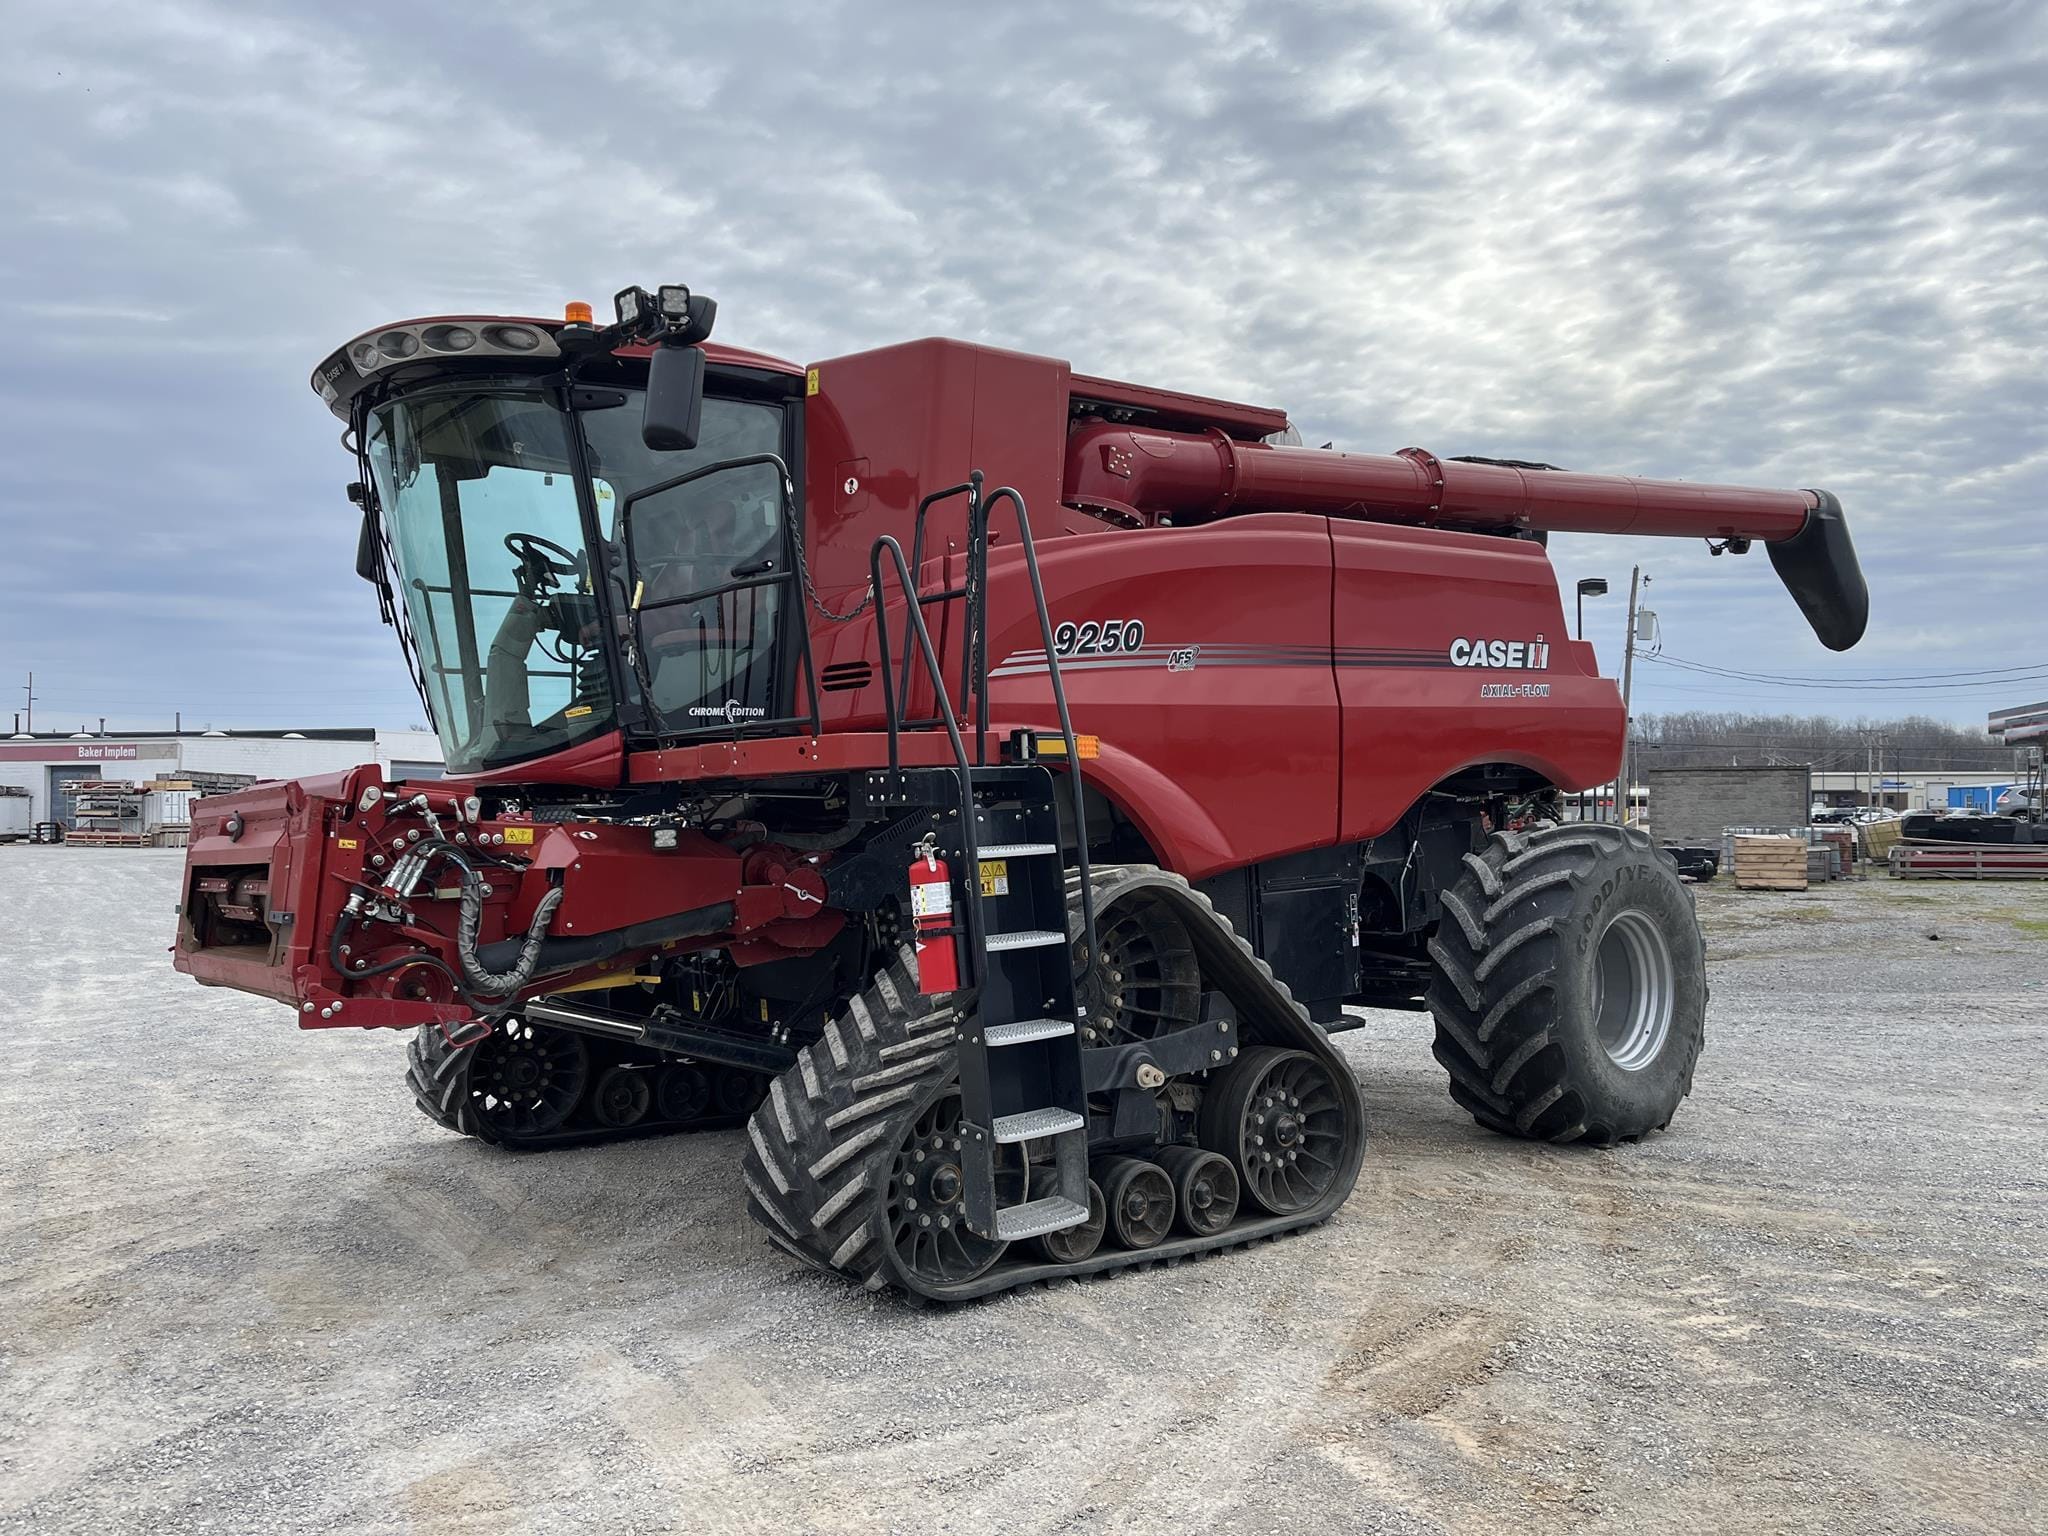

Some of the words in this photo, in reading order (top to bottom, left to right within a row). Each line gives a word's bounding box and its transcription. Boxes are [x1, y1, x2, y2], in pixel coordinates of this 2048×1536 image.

[1055, 619, 1145, 656] 9250
[1168, 650, 1194, 665] AFS
[1449, 638, 1524, 668] CASE
[1481, 684, 1550, 697] AXIAL-FLOW
[688, 707, 725, 716] CHROME
[732, 707, 765, 716] EDITION
[78, 746, 103, 758] Baker
[105, 746, 136, 759] Implem
